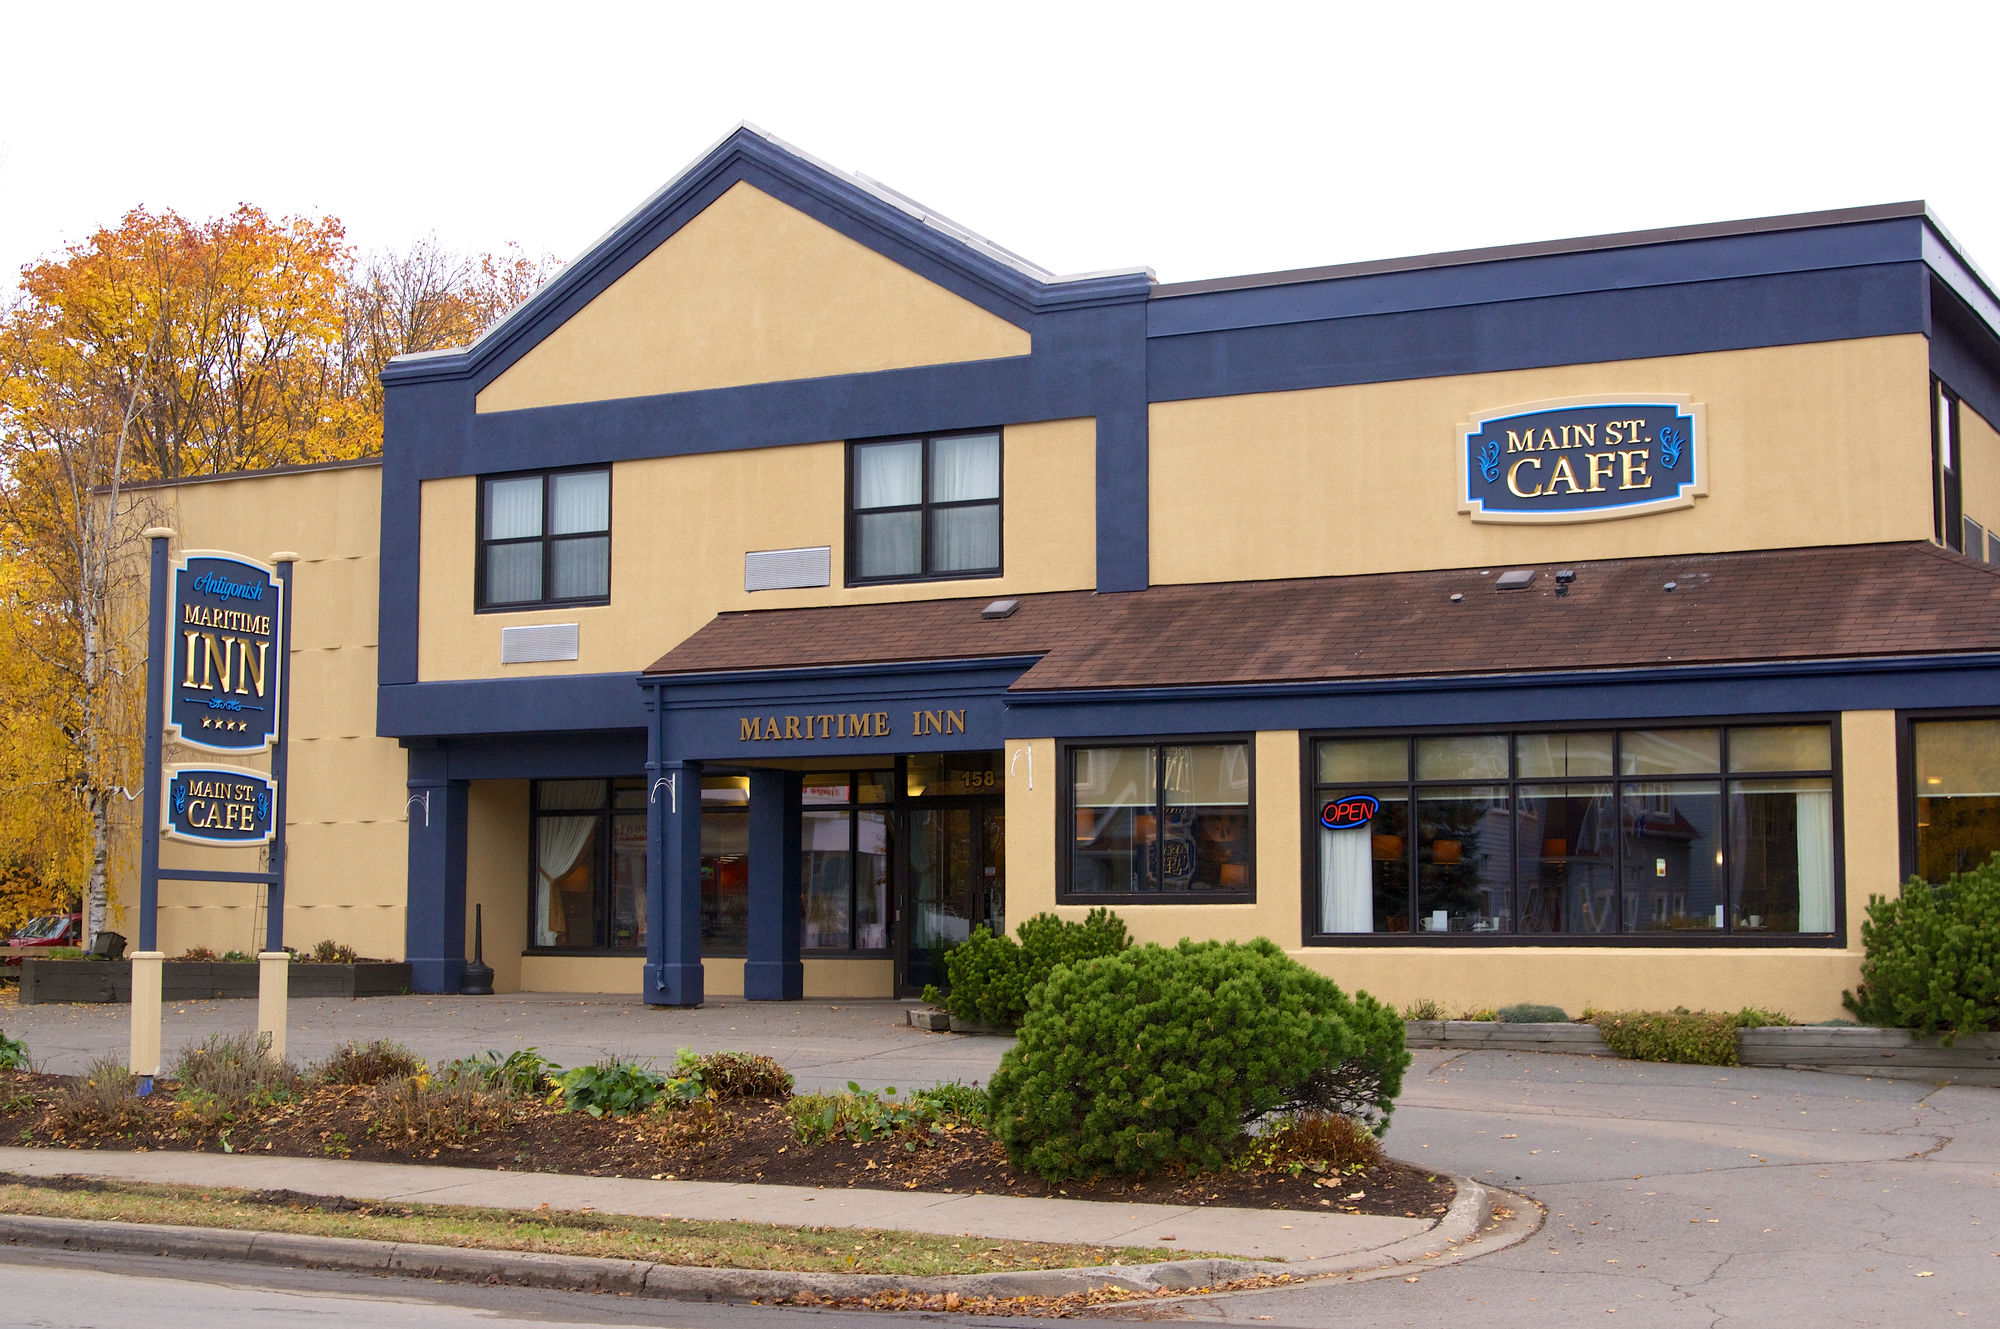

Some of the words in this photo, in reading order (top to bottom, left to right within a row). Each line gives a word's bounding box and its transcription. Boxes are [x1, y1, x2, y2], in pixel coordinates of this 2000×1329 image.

[1506, 423, 1598, 454] MAIN
[1605, 418, 1653, 446] ST.
[1506, 448, 1653, 498] CAFE
[193, 571, 264, 602] Antigonish
[184, 603, 271, 635] MARITIME
[182, 630, 270, 698] INN
[740, 711, 891, 742] MARITIME
[912, 709, 967, 737] INN
[188, 779, 232, 799] MAIN
[234, 785, 257, 803] ST.
[960, 770, 996, 788] 158
[187, 799, 255, 832] CAFE
[1323, 802, 1374, 823] OPEN
